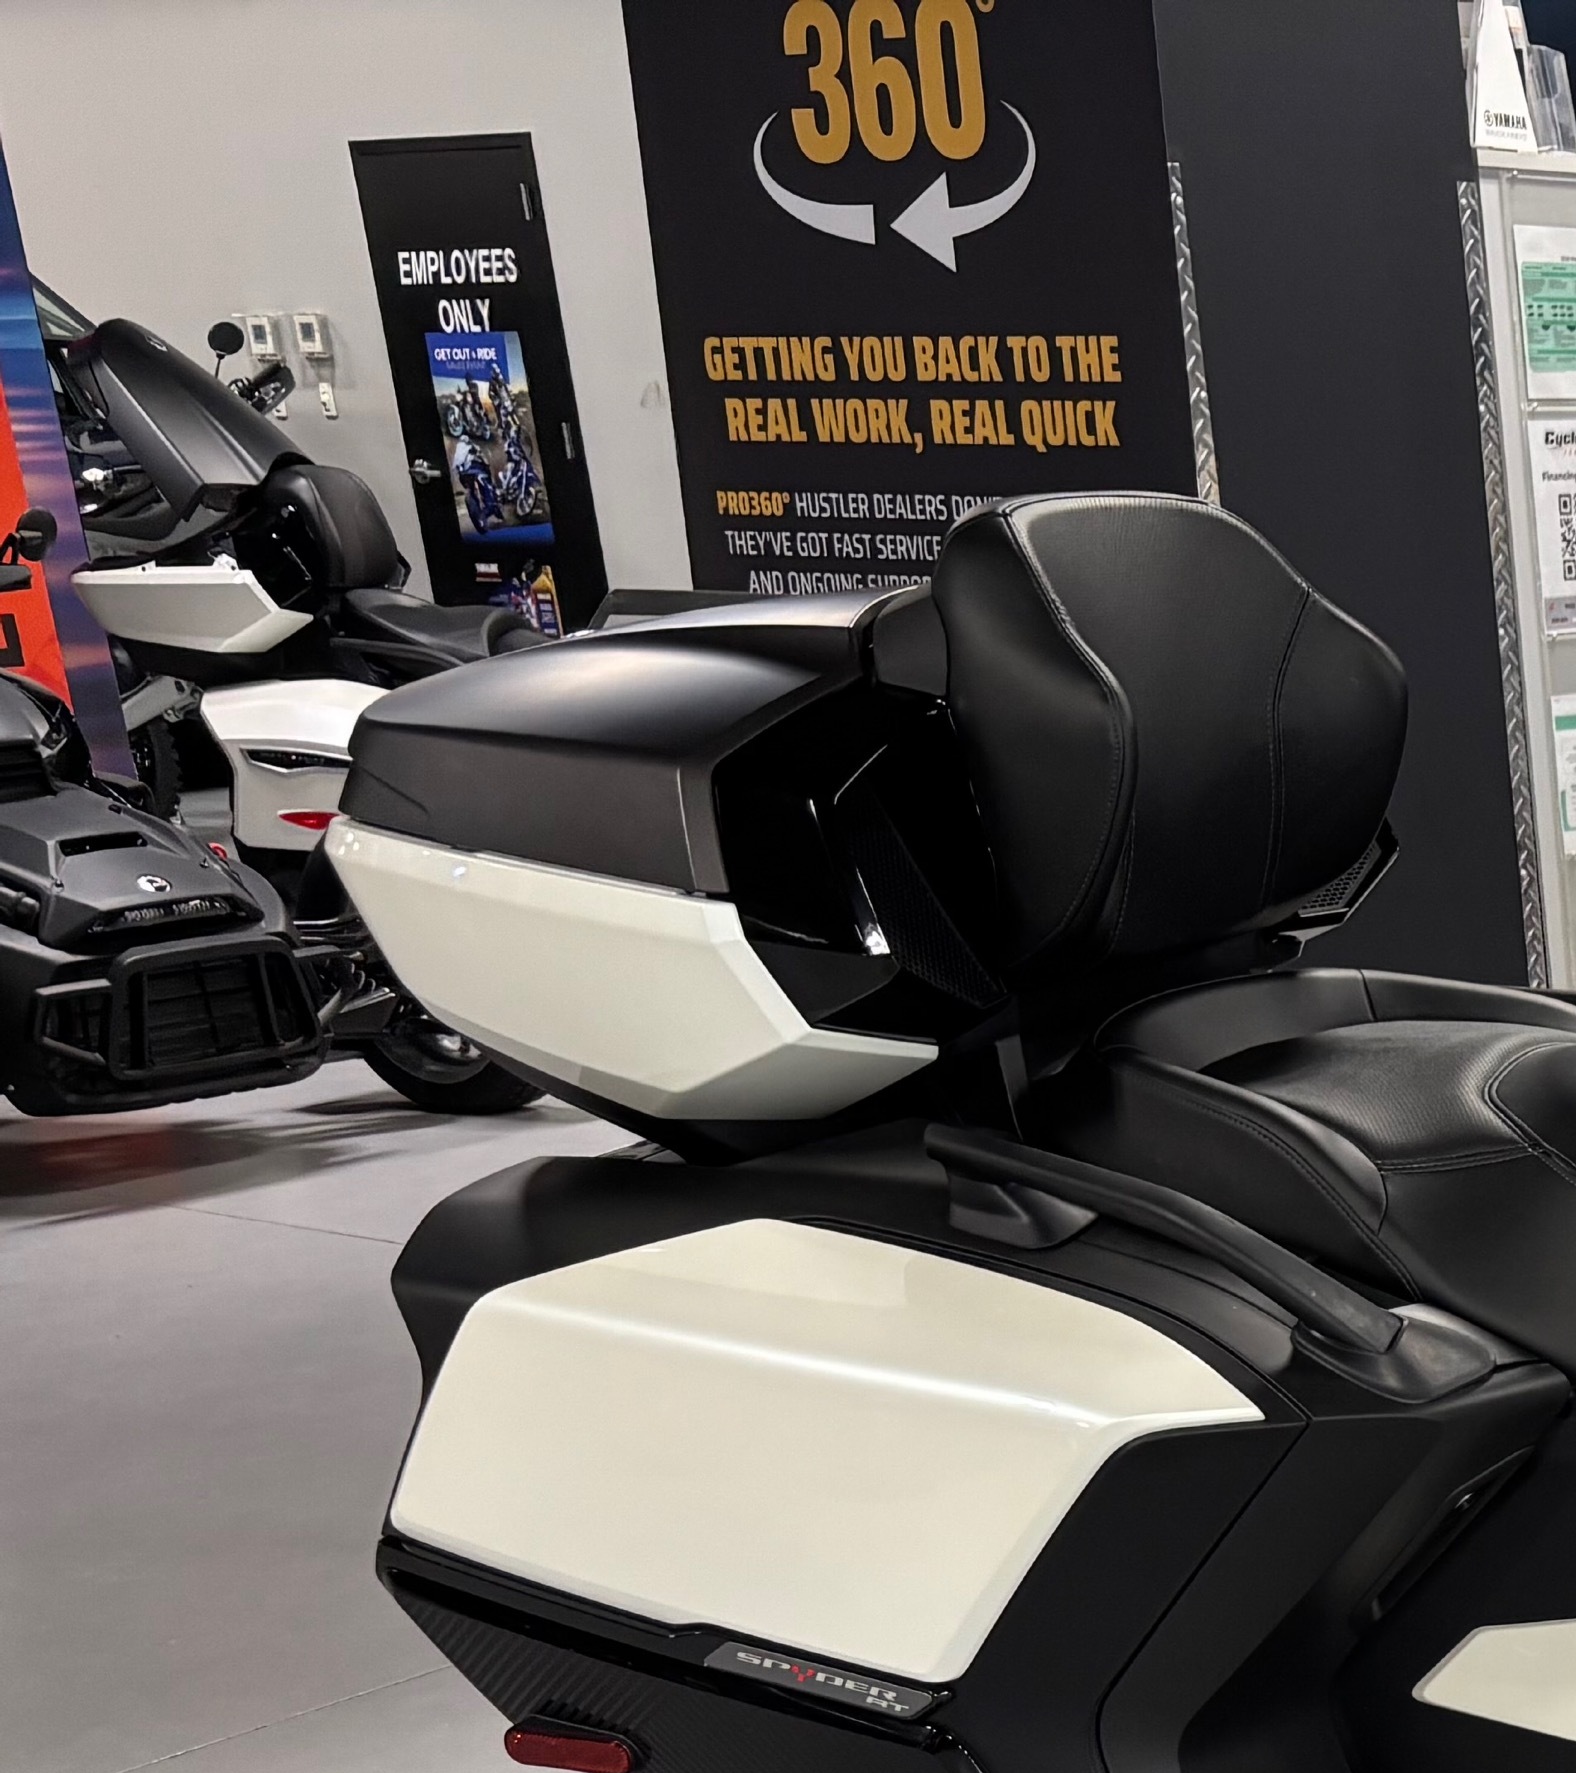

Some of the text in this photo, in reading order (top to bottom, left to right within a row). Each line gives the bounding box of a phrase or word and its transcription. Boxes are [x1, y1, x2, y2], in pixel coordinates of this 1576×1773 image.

[1493, 113, 1527, 129] YAMAHA
[398, 248, 518, 285] EMPLOYEES
[438, 298, 490, 333] ONLY
[452, 348, 470, 360] OUT
[476, 347, 497, 360] RIDE
[703, 335, 1122, 383] GETTING YOU BACK TO THE
[724, 398, 1120, 453] REAL WORK, REAL QUICK
[795, 491, 870, 519] HUSTLER
[874, 493, 948, 521] DEALERS
[724, 530, 793, 557] THEY'VE
[797, 532, 829, 558] GOT
[833, 533, 874, 559] FAST
[749, 570, 783, 594] AND
[787, 571, 863, 594] ONGOING
[737, 1651, 898, 1699] SPYDER
[865, 1695, 909, 1712] RT
